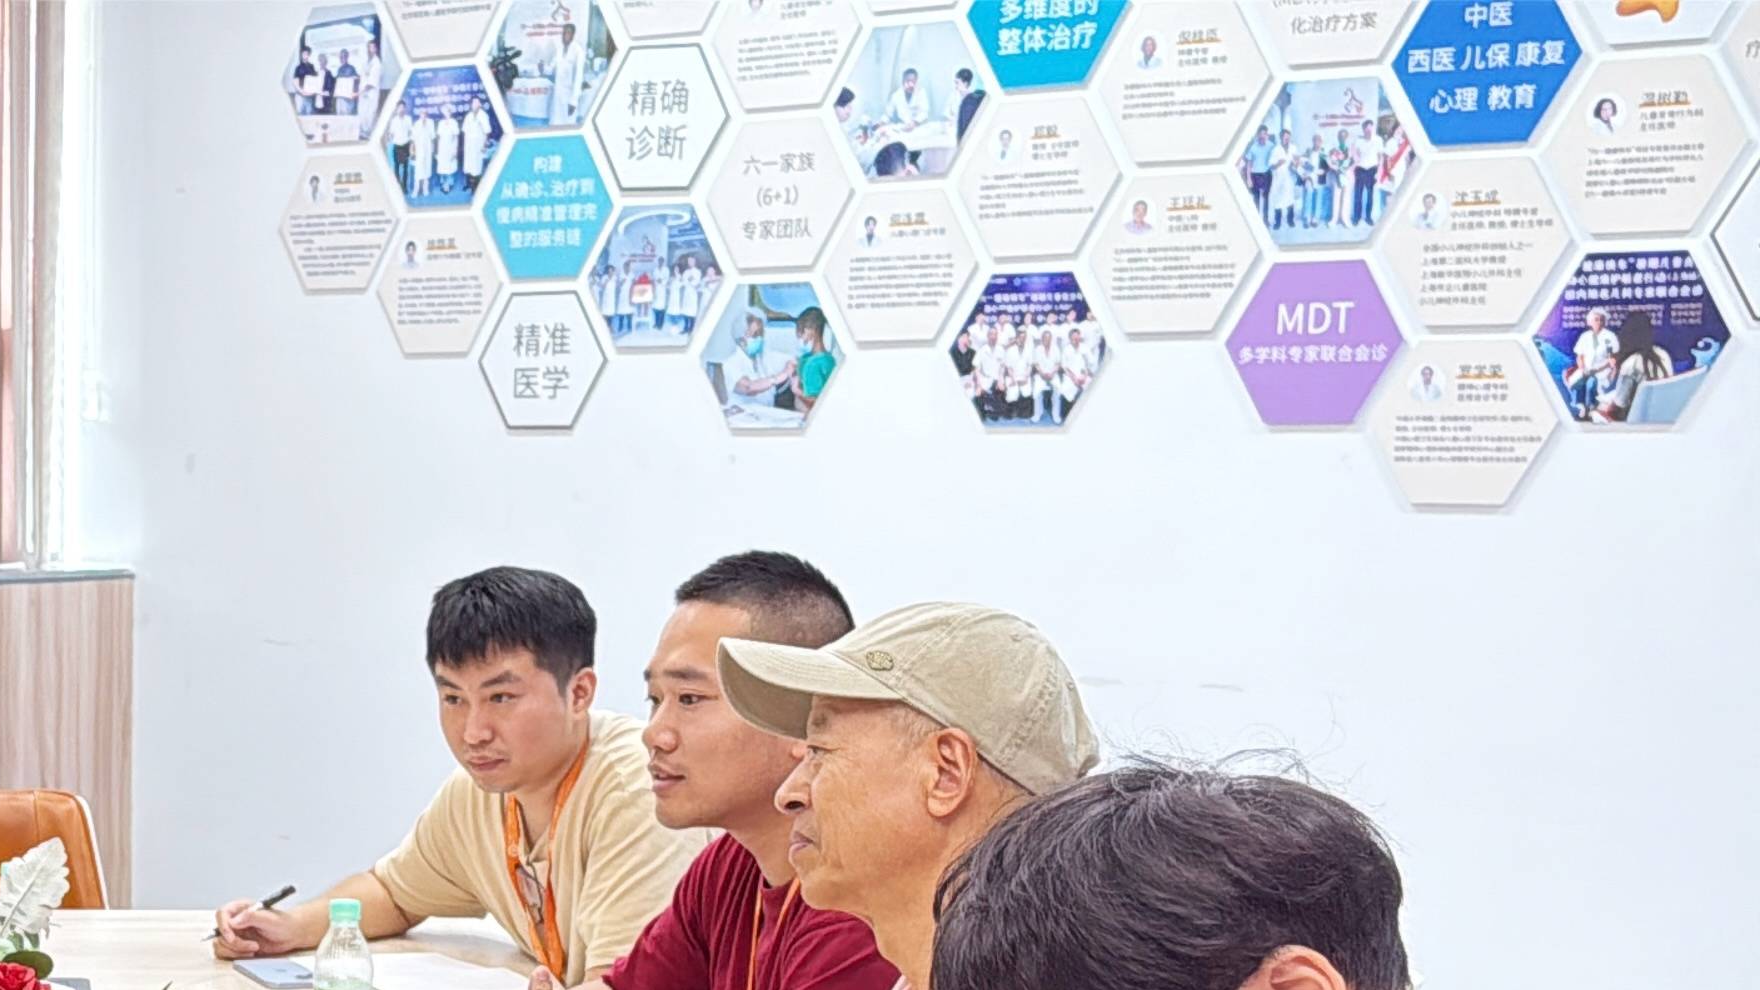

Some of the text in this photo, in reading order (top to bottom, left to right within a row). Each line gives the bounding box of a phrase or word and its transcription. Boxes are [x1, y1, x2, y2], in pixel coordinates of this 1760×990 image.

[1290, 11, 1378, 35] 化治疗方案
[1463, 1, 1514, 29] 中医
[996, 20, 1098, 56] 整体治疗
[1407, 40, 1566, 74] 西医 儿保 康复
[628, 78, 689, 116] 精确
[1428, 83, 1537, 114] 心理 教育
[626, 124, 687, 161] 诊断
[743, 152, 816, 176] 六一家族
[756, 185, 799, 208] (6+1)
[742, 216, 812, 240] 专家团队
[1276, 301, 1356, 336] MDT
[513, 322, 571, 357] 精准
[1237, 343, 1389, 365] 多学科专家联合会诊
[513, 365, 570, 400] 医学
